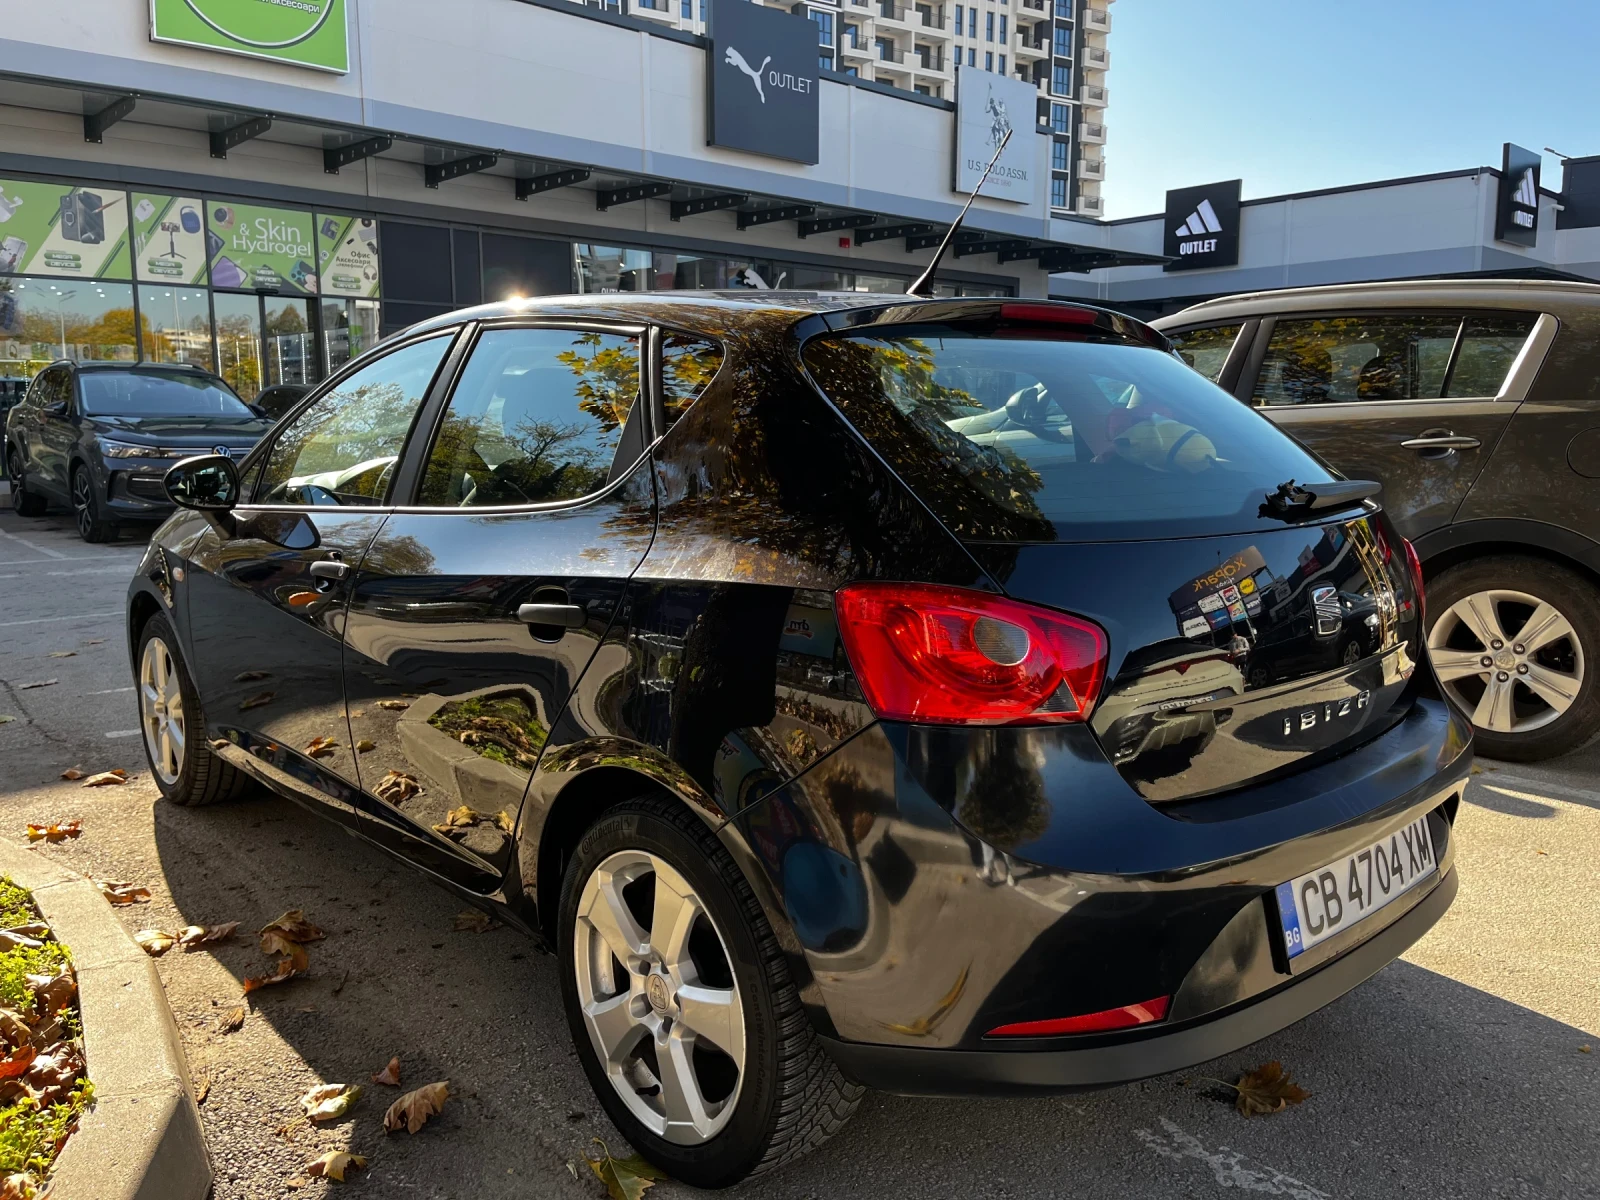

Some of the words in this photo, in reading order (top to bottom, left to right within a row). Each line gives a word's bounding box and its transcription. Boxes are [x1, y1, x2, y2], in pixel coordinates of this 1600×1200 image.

[769, 71, 812, 94] OUTLET
[967, 159, 983, 172] U.S.
[984, 162, 1006, 177] POLO
[1006, 167, 1029, 182] ASSN.
[255, 218, 300, 242] Skin
[1513, 210, 1534, 228] OUTLET
[233, 234, 311, 258] Hydrogel
[350, 250, 371, 259] Офис
[1180, 239, 1217, 255] OUTLET
[336, 256, 371, 266] Аксесоари
[1284, 689, 1370, 735] IBIZA
[1302, 871, 1343, 937] CB
[1348, 835, 1404, 912] 4704
[1401, 818, 1432, 879] XM
[1285, 927, 1300, 947] BG
